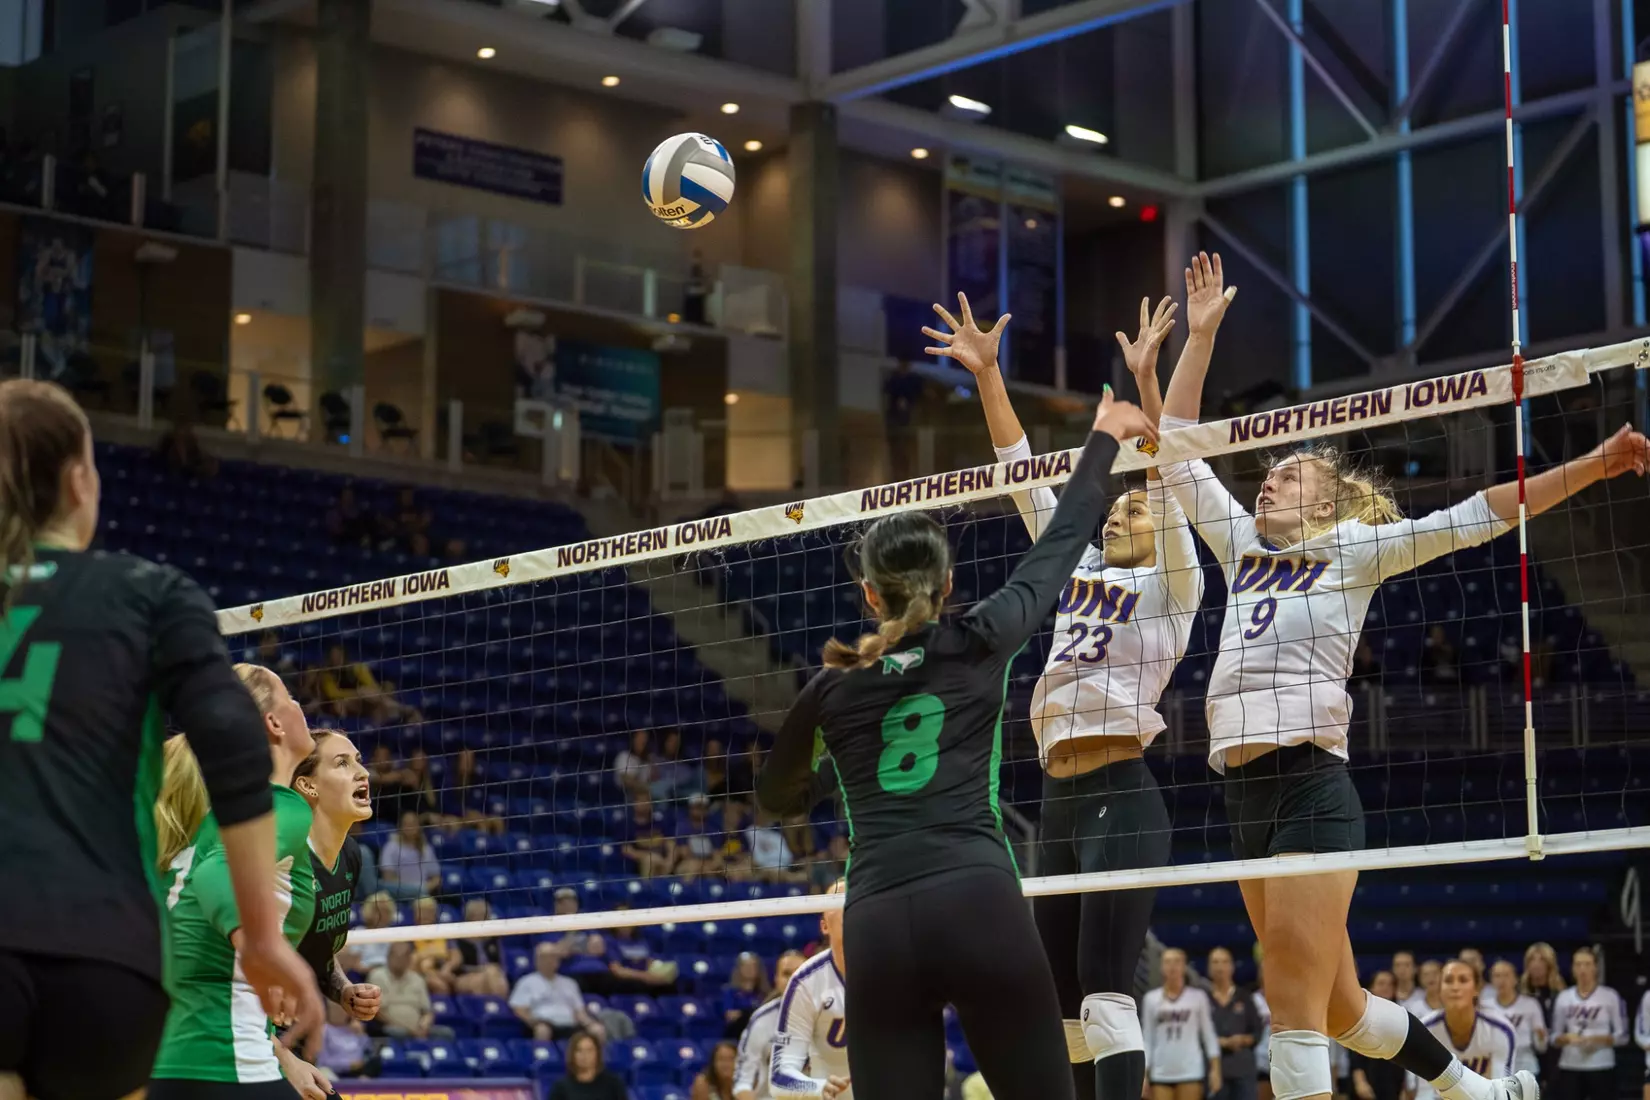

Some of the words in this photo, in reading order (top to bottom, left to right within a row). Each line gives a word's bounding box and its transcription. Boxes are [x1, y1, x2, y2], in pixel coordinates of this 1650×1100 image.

[1229, 388, 1393, 445] NORTHERN
[1404, 371, 1487, 411] IOWA
[860, 465, 995, 512] NORTHERN
[1004, 451, 1071, 485] IOWA
[557, 527, 668, 568] NORTHERN
[675, 516, 732, 546] IOWA
[301, 579, 396, 614] NORTHERN
[402, 569, 450, 596] IOWA
[1231, 553, 1333, 594] UNI
[1056, 576, 1142, 625] UNI
[1243, 596, 1278, 641] 9
[1053, 621, 1114, 663] 23
[876, 692, 946, 795] 8
[315, 907, 352, 933] DAKOT
